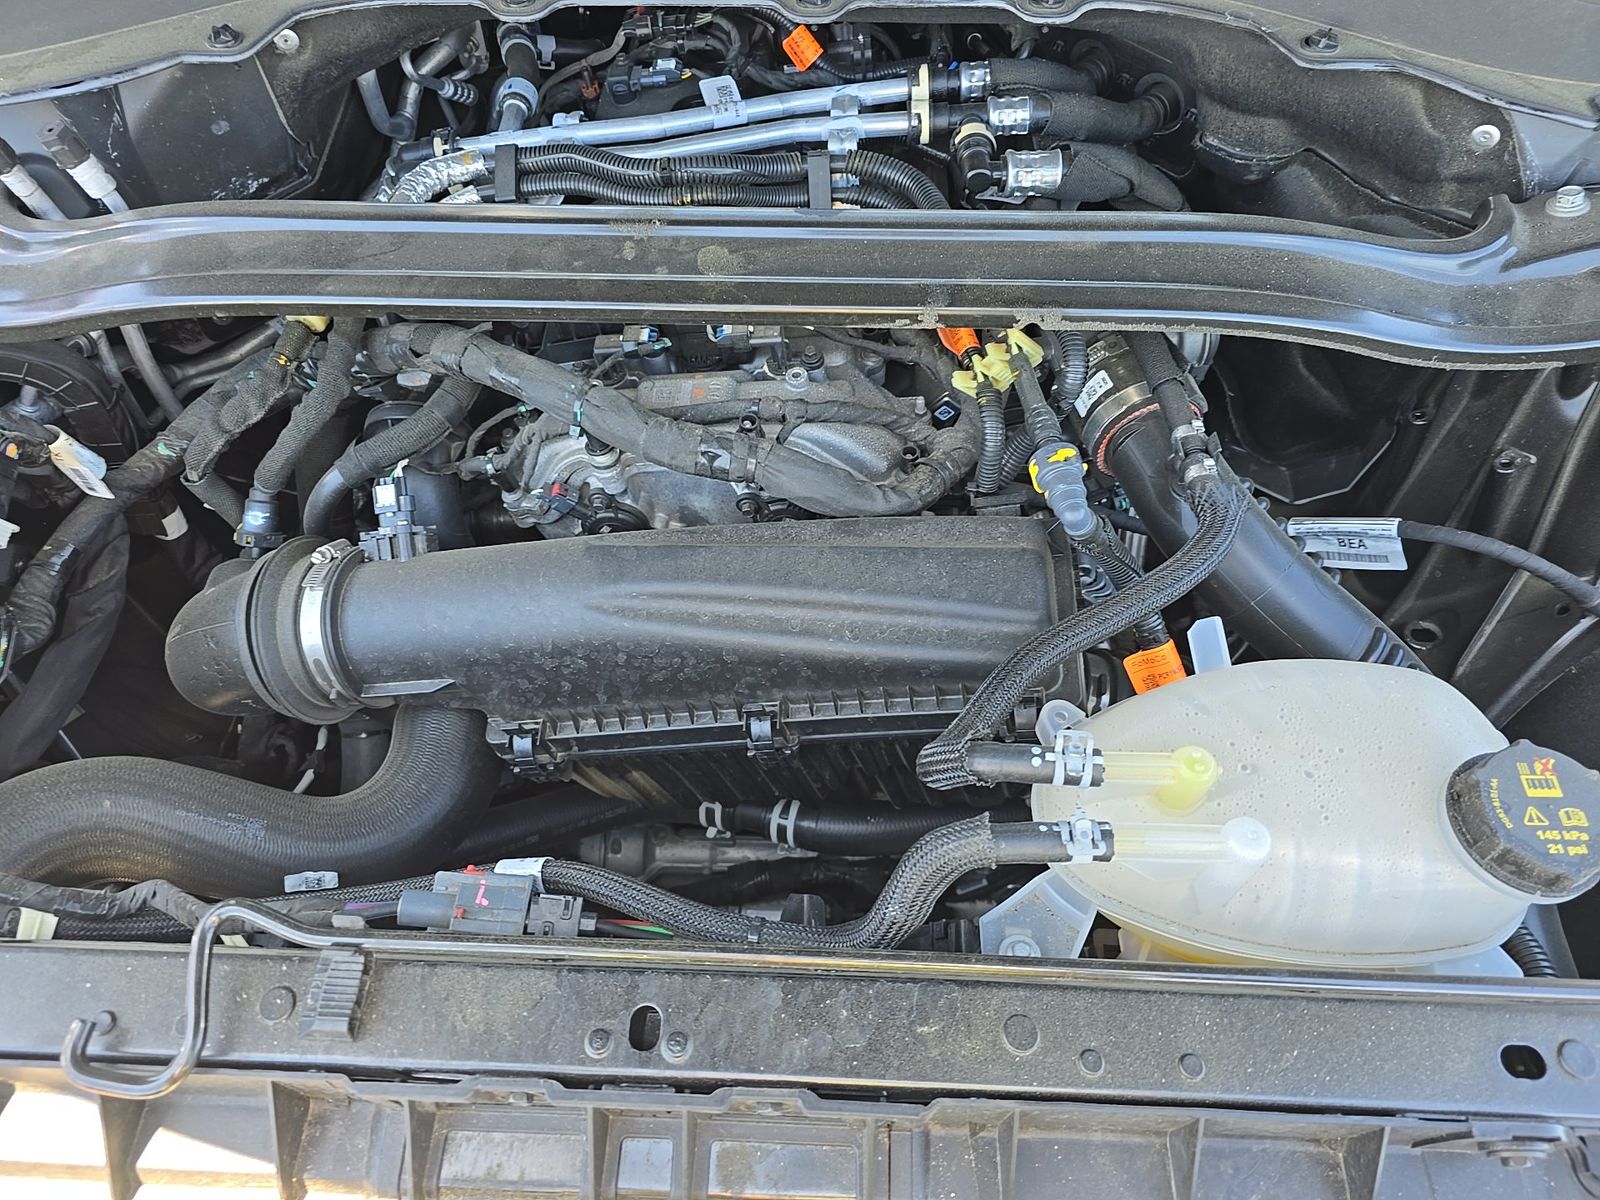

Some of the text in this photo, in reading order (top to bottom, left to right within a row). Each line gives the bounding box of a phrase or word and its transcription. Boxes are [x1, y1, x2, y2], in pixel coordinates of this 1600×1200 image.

[1337, 538, 1368, 550] BEA
[1131, 654, 1168, 668] FoMoCo
[1536, 830, 1590, 841] 145 kPa
[1547, 843, 1589, 857] 21 psi
